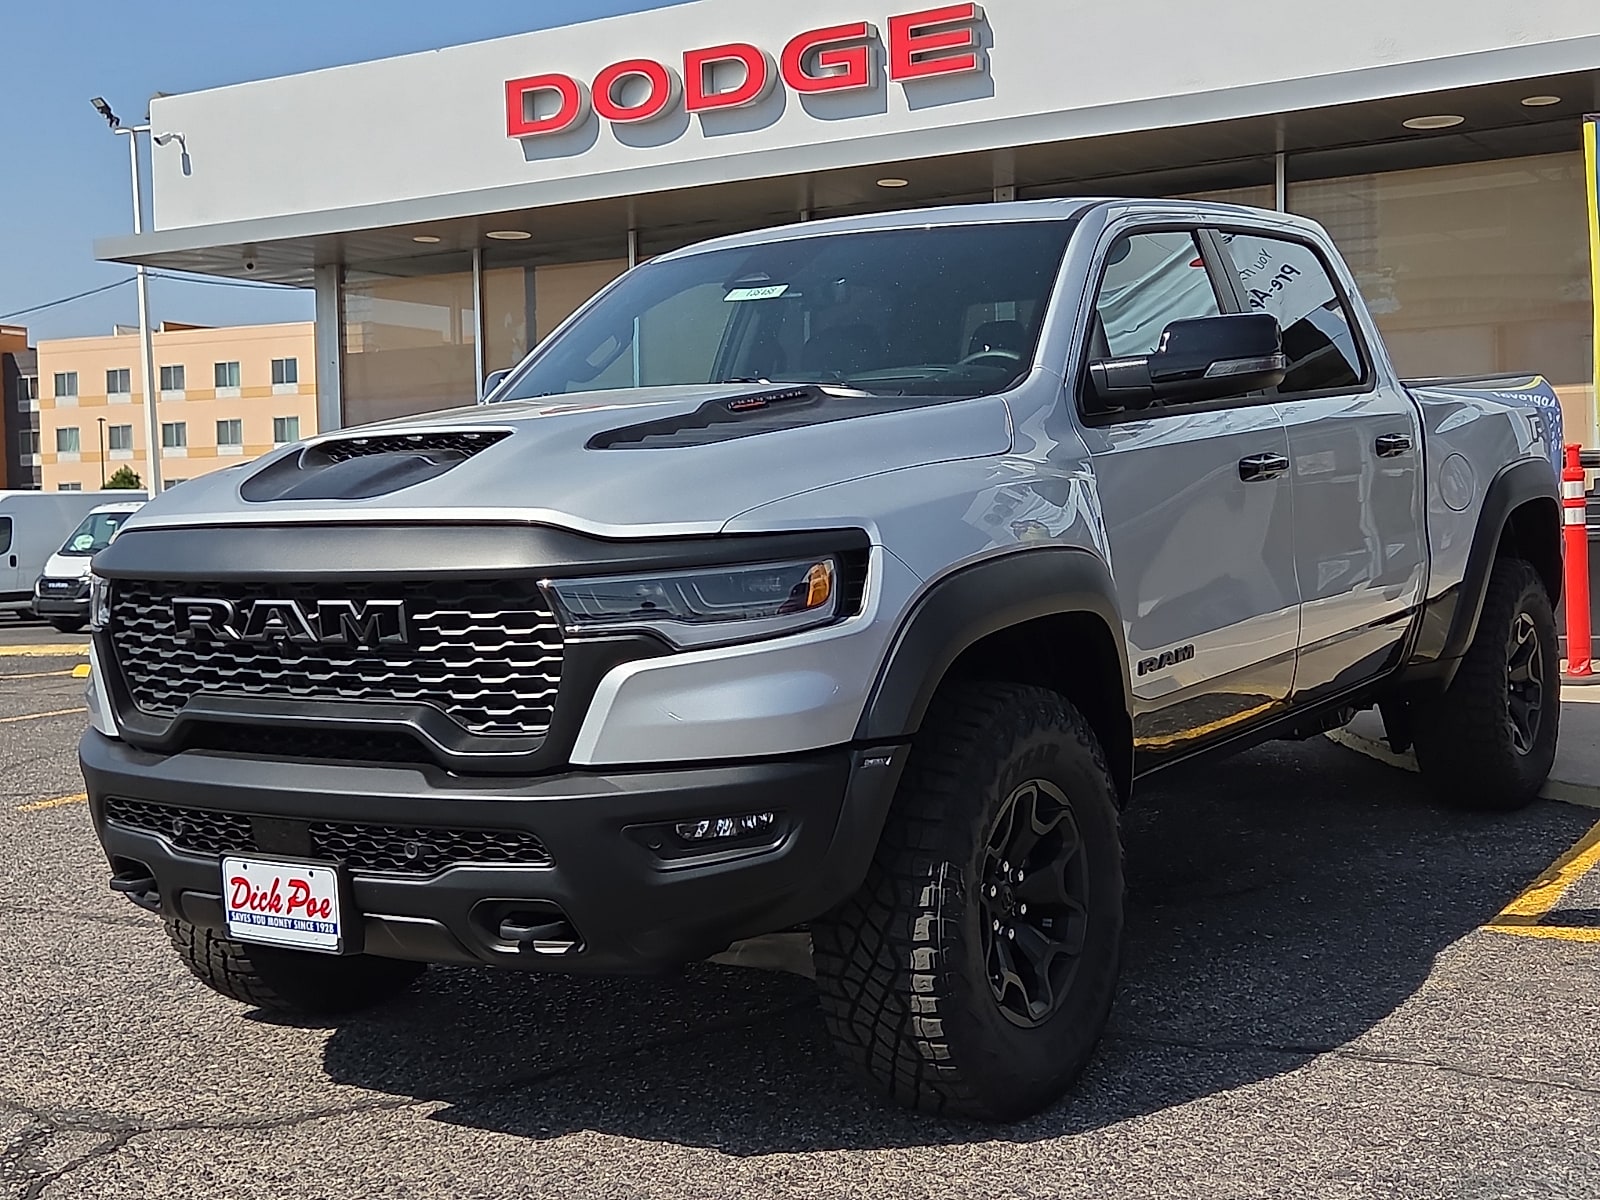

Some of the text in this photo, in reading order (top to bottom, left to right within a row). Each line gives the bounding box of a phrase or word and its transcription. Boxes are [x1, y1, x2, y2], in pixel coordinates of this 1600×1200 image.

[504, 2, 979, 138] DODGE
[172, 597, 408, 643] RAM
[1137, 643, 1195, 676] RAM
[230, 876, 333, 919] Dick Poe
[231, 911, 335, 934] SAVES YOU MONEY SINCE 1928
